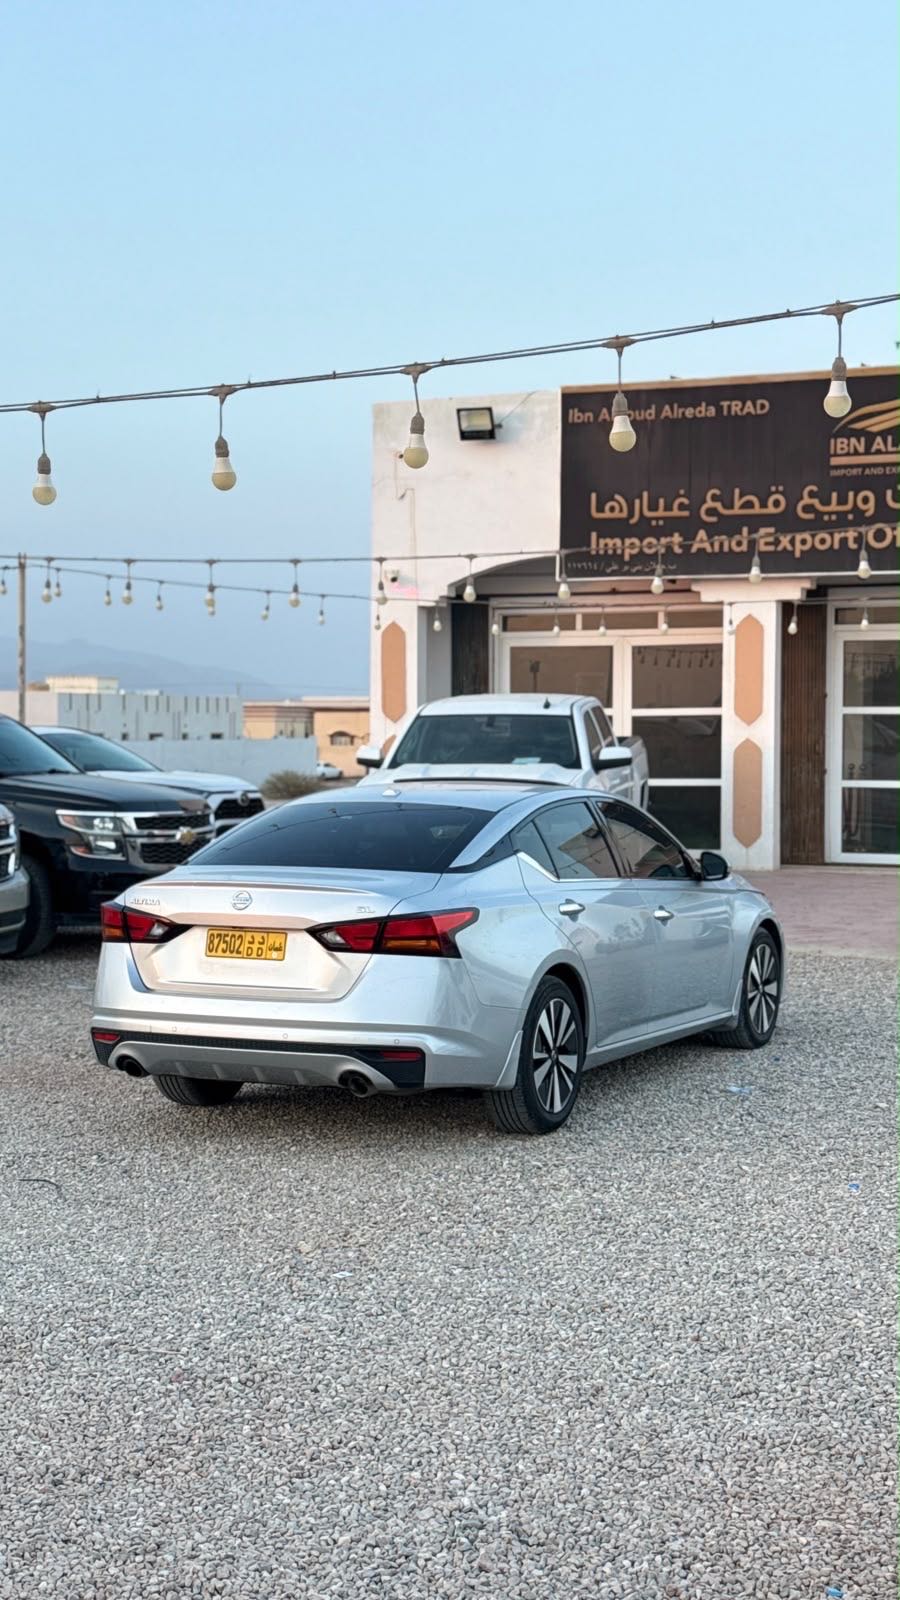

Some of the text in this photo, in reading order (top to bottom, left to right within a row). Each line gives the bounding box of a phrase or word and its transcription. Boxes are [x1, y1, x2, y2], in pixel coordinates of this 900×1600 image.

[568, 399, 770, 424] Ibn Aoud Alreda TRAD
[830, 436, 866, 454] IBN
[590, 489, 690, 526] غيارها
[700, 485, 787, 523] قطع
[796, 484, 876, 521] وبيع
[590, 531, 683, 561] Import
[690, 526, 748, 553] And
[758, 526, 858, 558] Export
[208, 932, 244, 955] 87502
